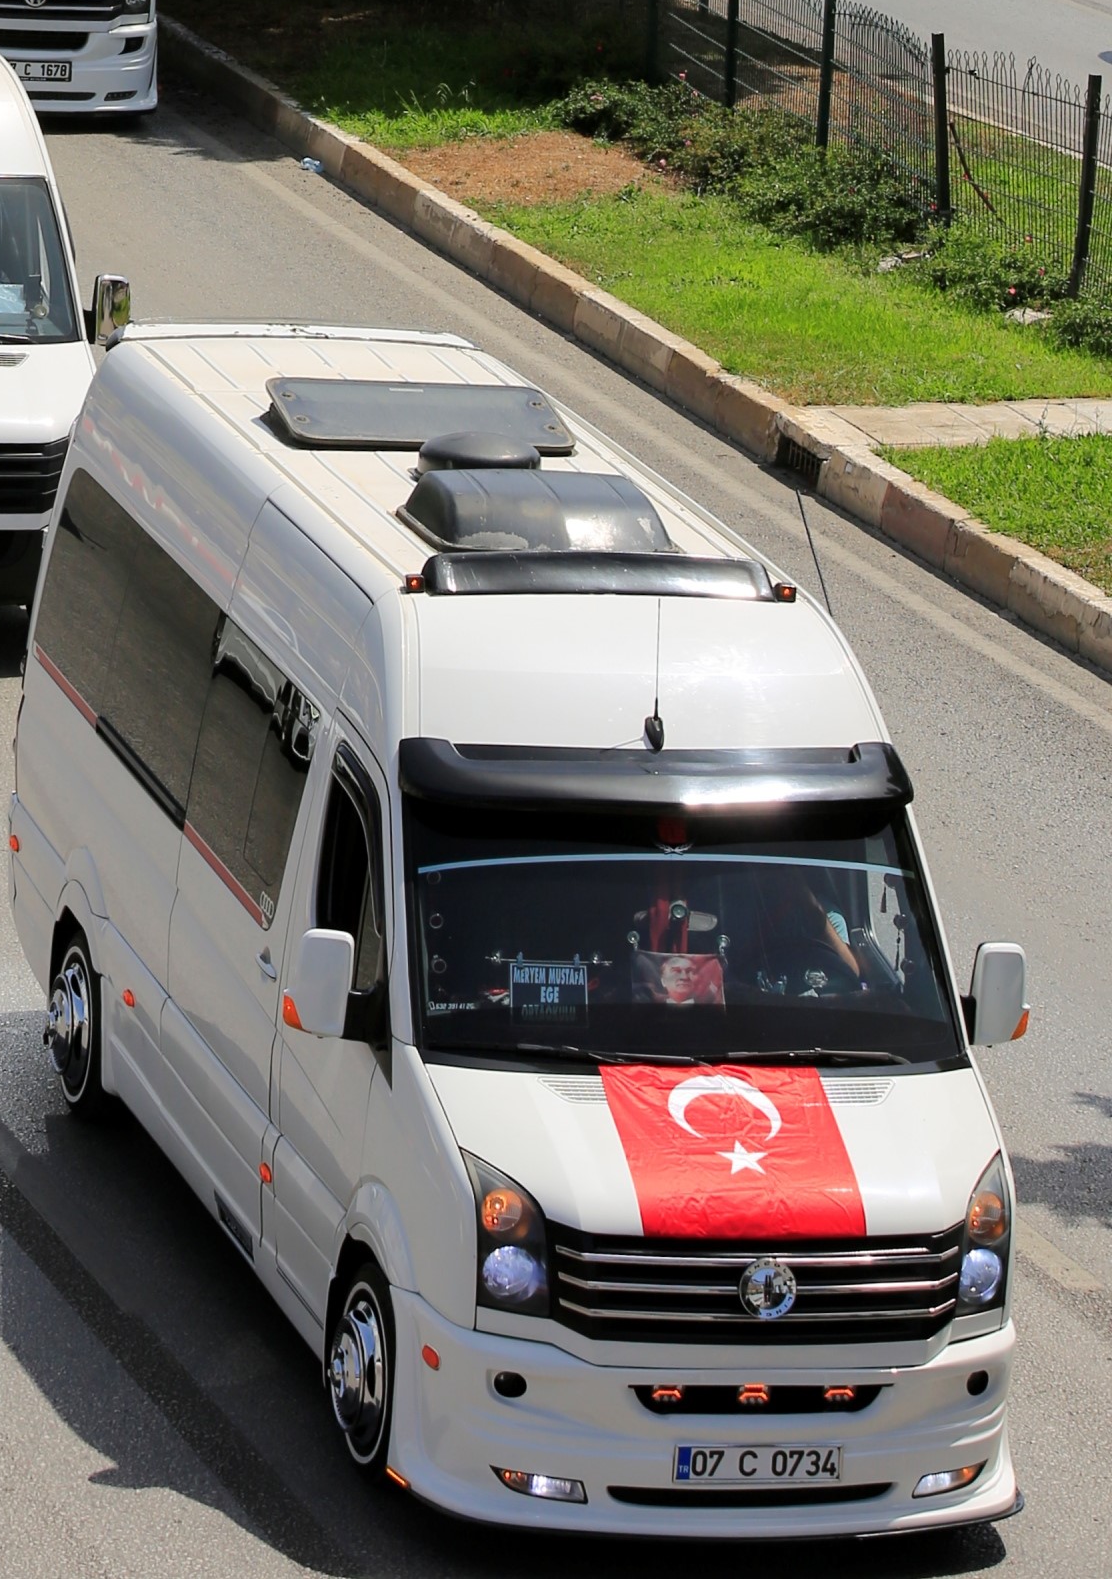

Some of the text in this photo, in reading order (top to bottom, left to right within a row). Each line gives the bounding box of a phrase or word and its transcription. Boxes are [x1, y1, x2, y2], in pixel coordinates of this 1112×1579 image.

[24, 63, 31, 76] C
[41, 64, 67, 77] 1678
[513, 967, 585, 986] MERYEM MUSTAFA
[540, 986, 559, 1003] EGE
[678, 1449, 837, 1477] TR 07 C 0734
